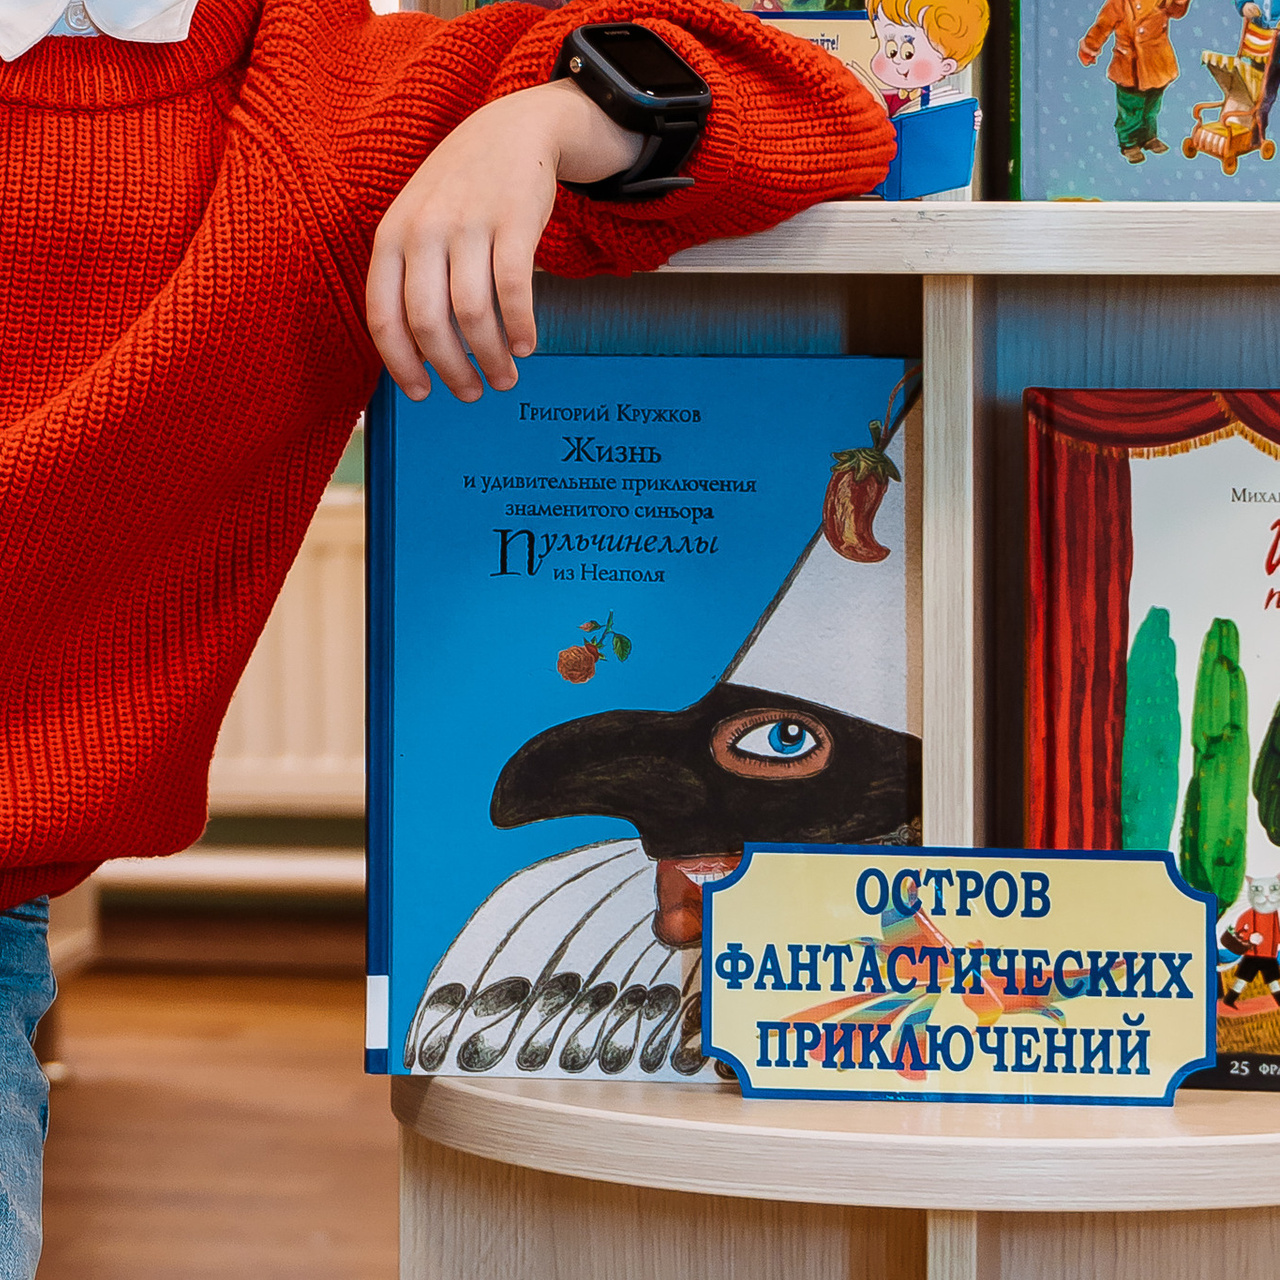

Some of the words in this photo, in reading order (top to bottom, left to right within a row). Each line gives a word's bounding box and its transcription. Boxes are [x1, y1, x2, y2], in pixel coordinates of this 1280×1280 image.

[463, 475, 476, 488] и
[481, 475, 617, 494] удивительные
[621, 477, 757, 496] приключения
[505, 504, 629, 518] знаменитого
[634, 506, 714, 524] синьора
[490, 528, 719, 577] Пульчинеллы
[553, 568, 575, 581] из
[580, 564, 665, 582] Неаполя
[856, 868, 1051, 918] ОСТРОВ
[715, 942, 1194, 999] ФАНТАСТИЧЕСКИХ
[756, 1012, 1151, 1075] ПРИКЛЮЧЕНИЙ
[1230, 1060, 1250, 1076] 25
